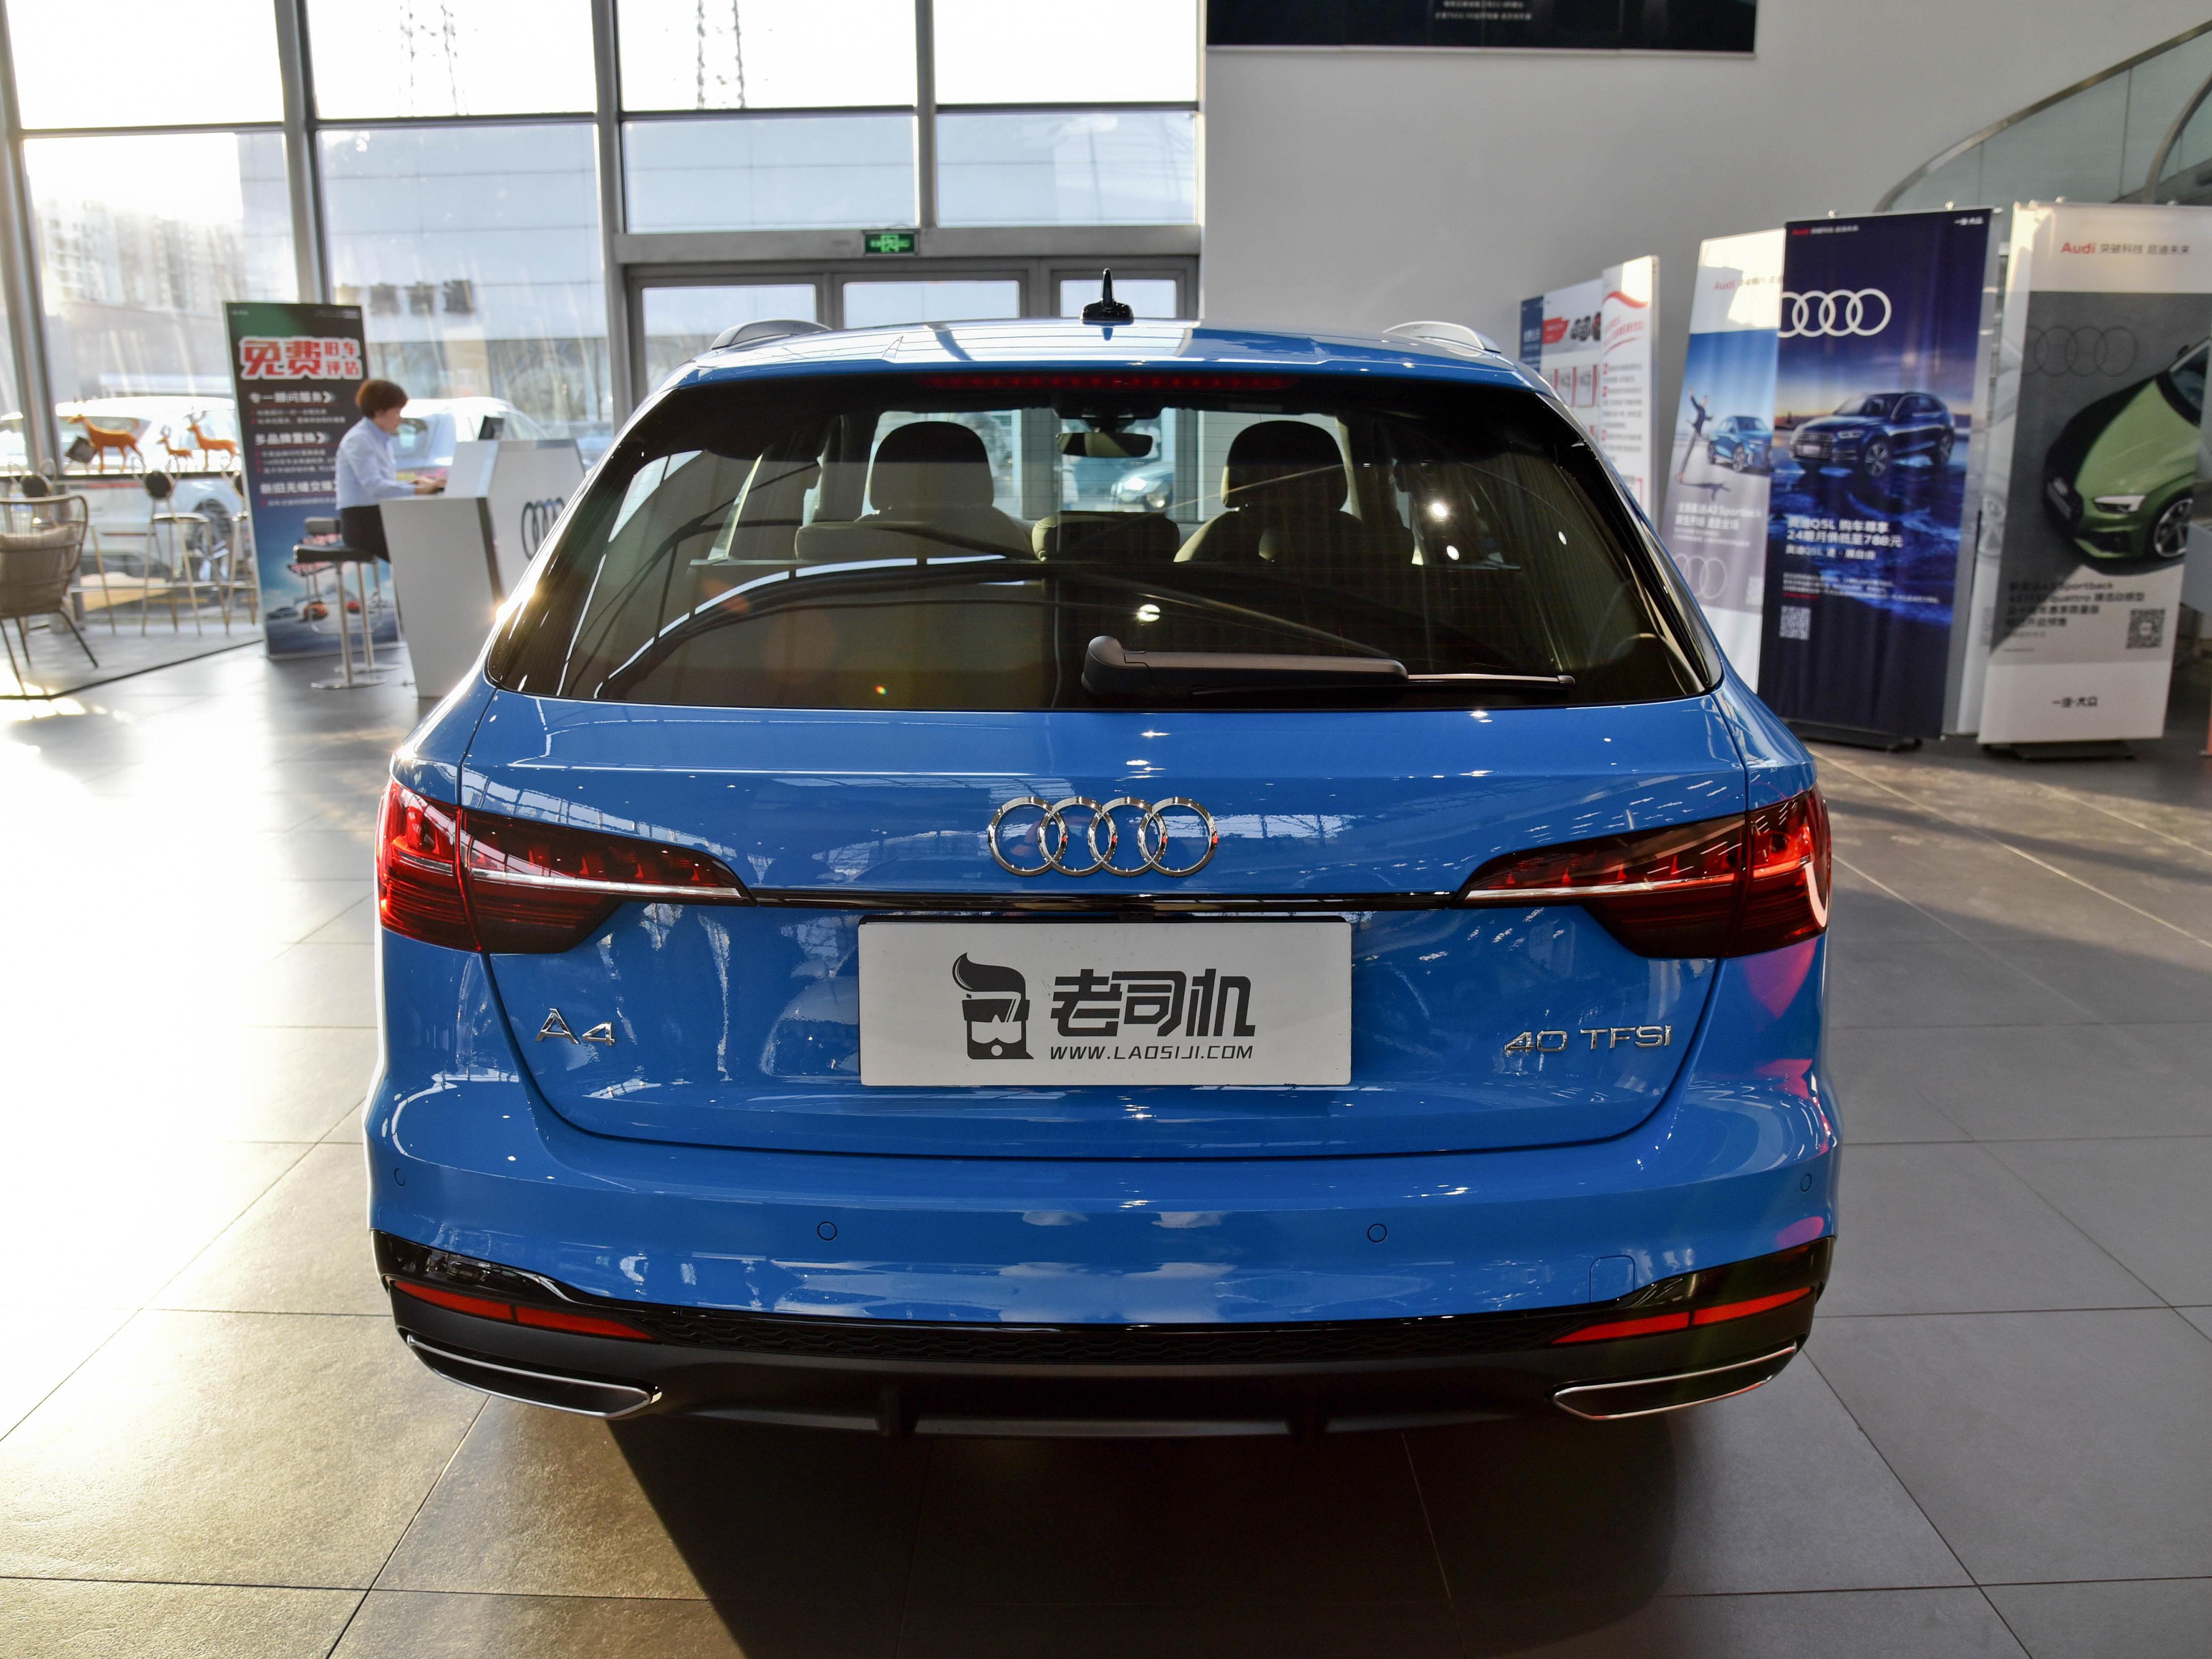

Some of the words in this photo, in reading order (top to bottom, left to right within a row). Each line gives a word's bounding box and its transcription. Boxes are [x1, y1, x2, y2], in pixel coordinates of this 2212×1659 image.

[2061, 241, 2096, 254] Audi
[243, 339, 323, 377] 免费
[1050, 968, 1256, 1037] 老司机
[535, 1007, 615, 1047] A4
[1504, 1031, 1568, 1053] 40
[1580, 1025, 1672, 1050] TFSI
[1050, 1045, 1254, 1060] WWW.LAOSIJI.COM
